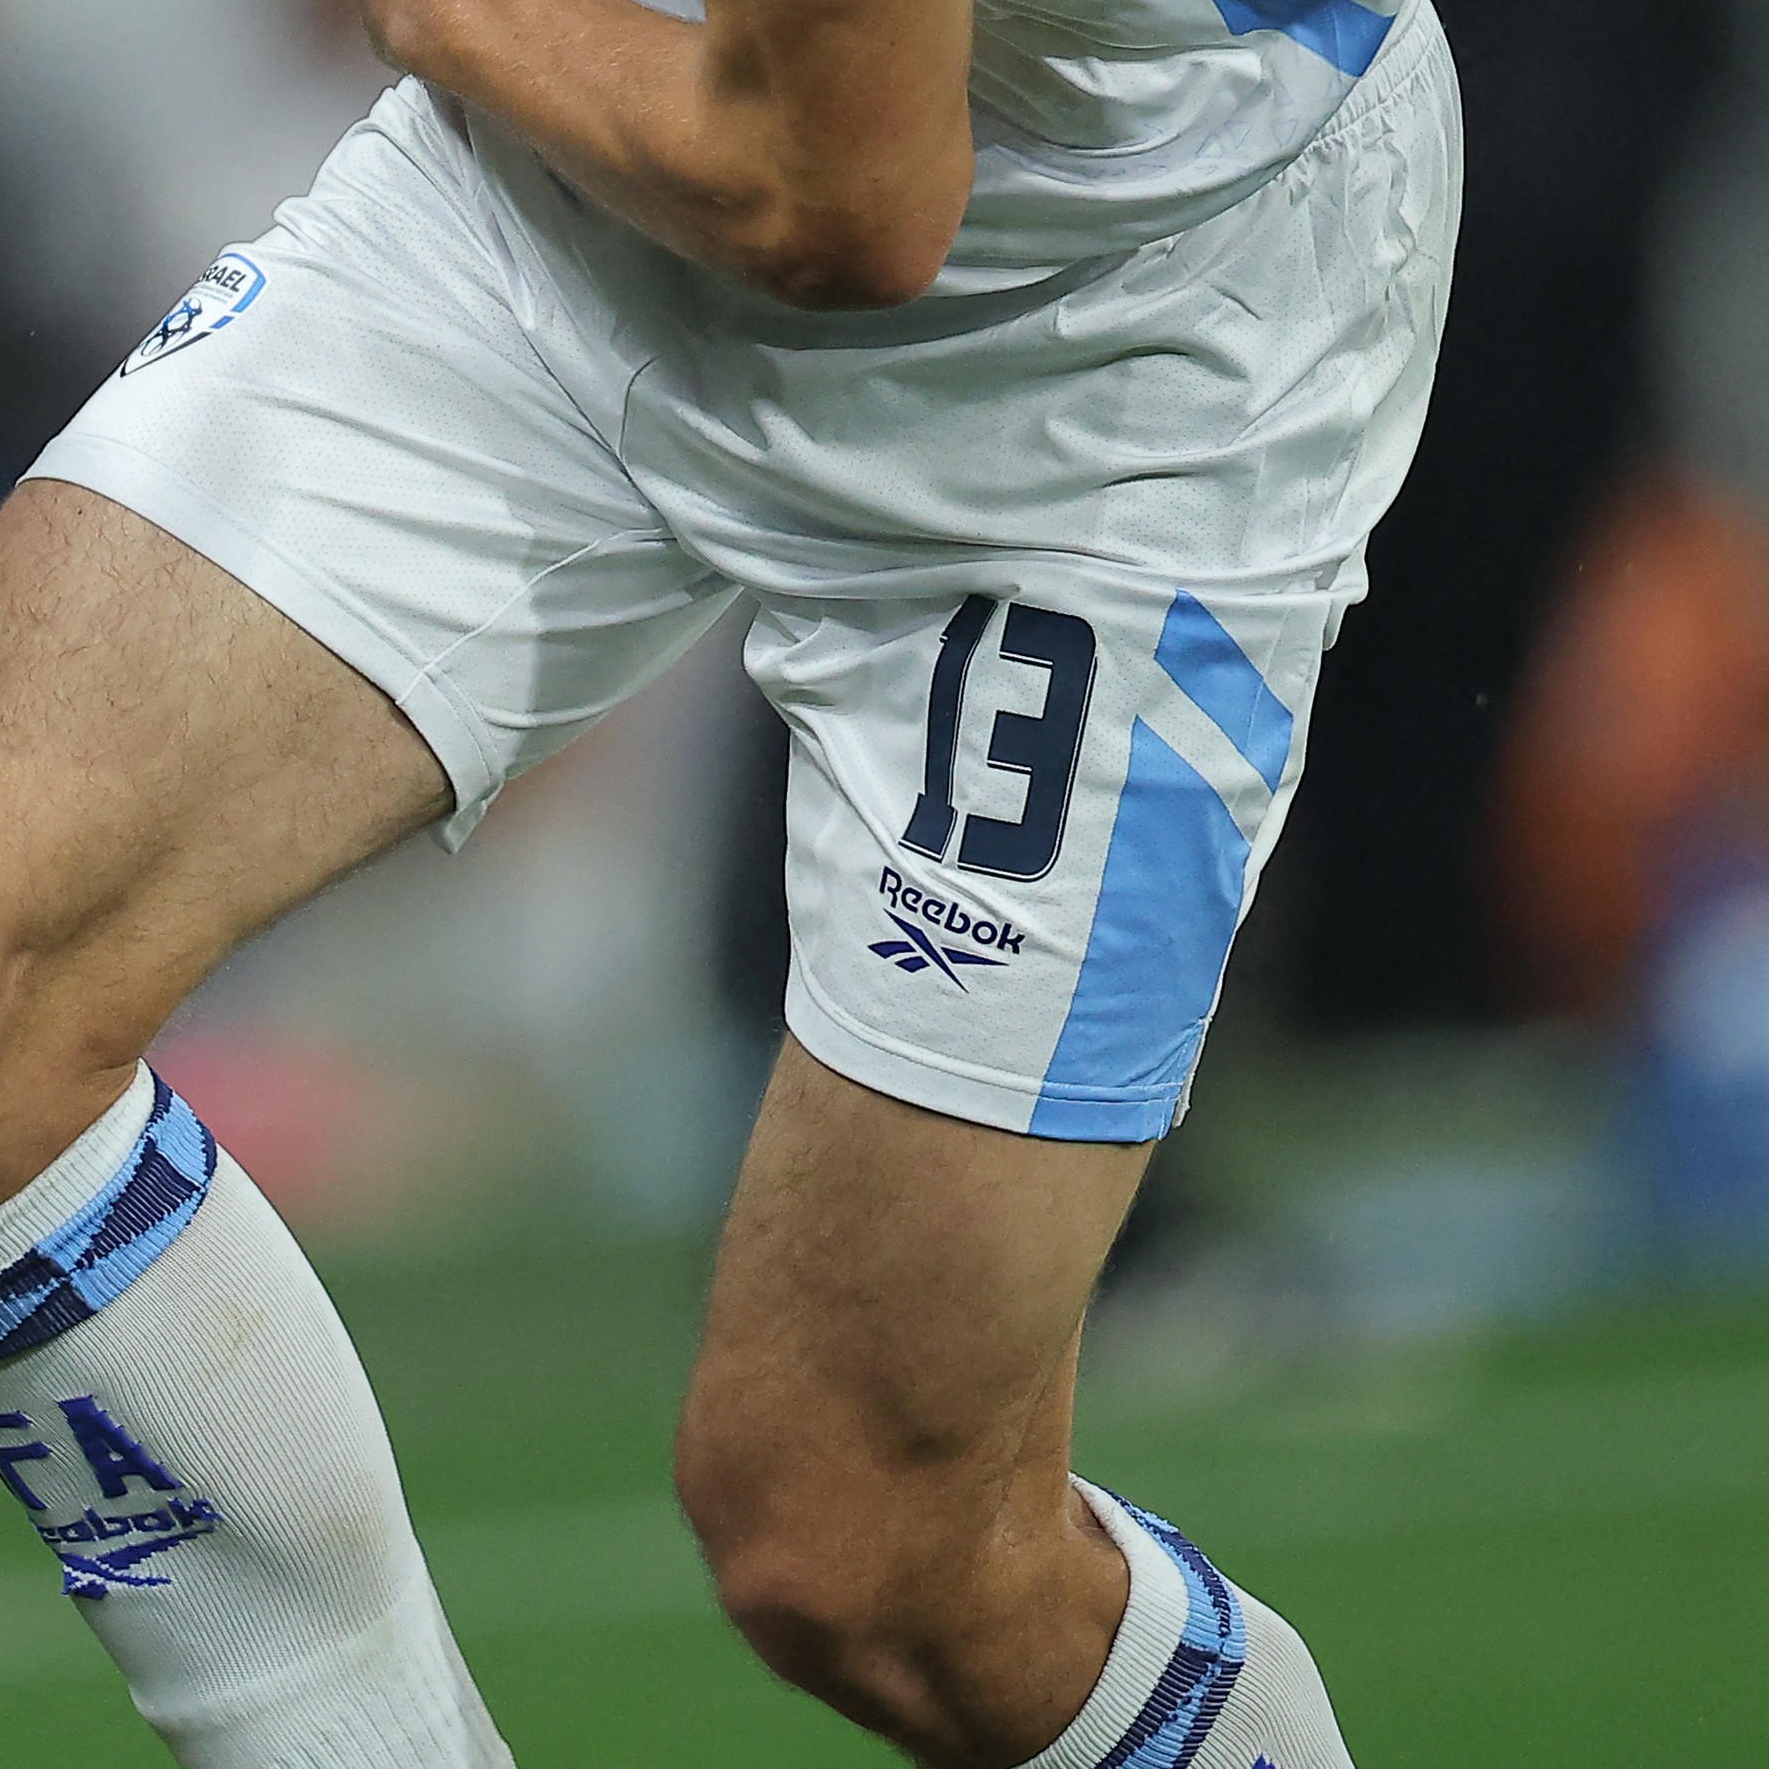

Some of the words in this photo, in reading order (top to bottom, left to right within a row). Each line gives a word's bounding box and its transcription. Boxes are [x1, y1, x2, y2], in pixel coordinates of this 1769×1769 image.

[198, 265, 247, 293] RAEL
[898, 594, 1097, 882] 13
[879, 866, 1026, 955] Reebok
[36, 1496, 225, 1543] eebok
